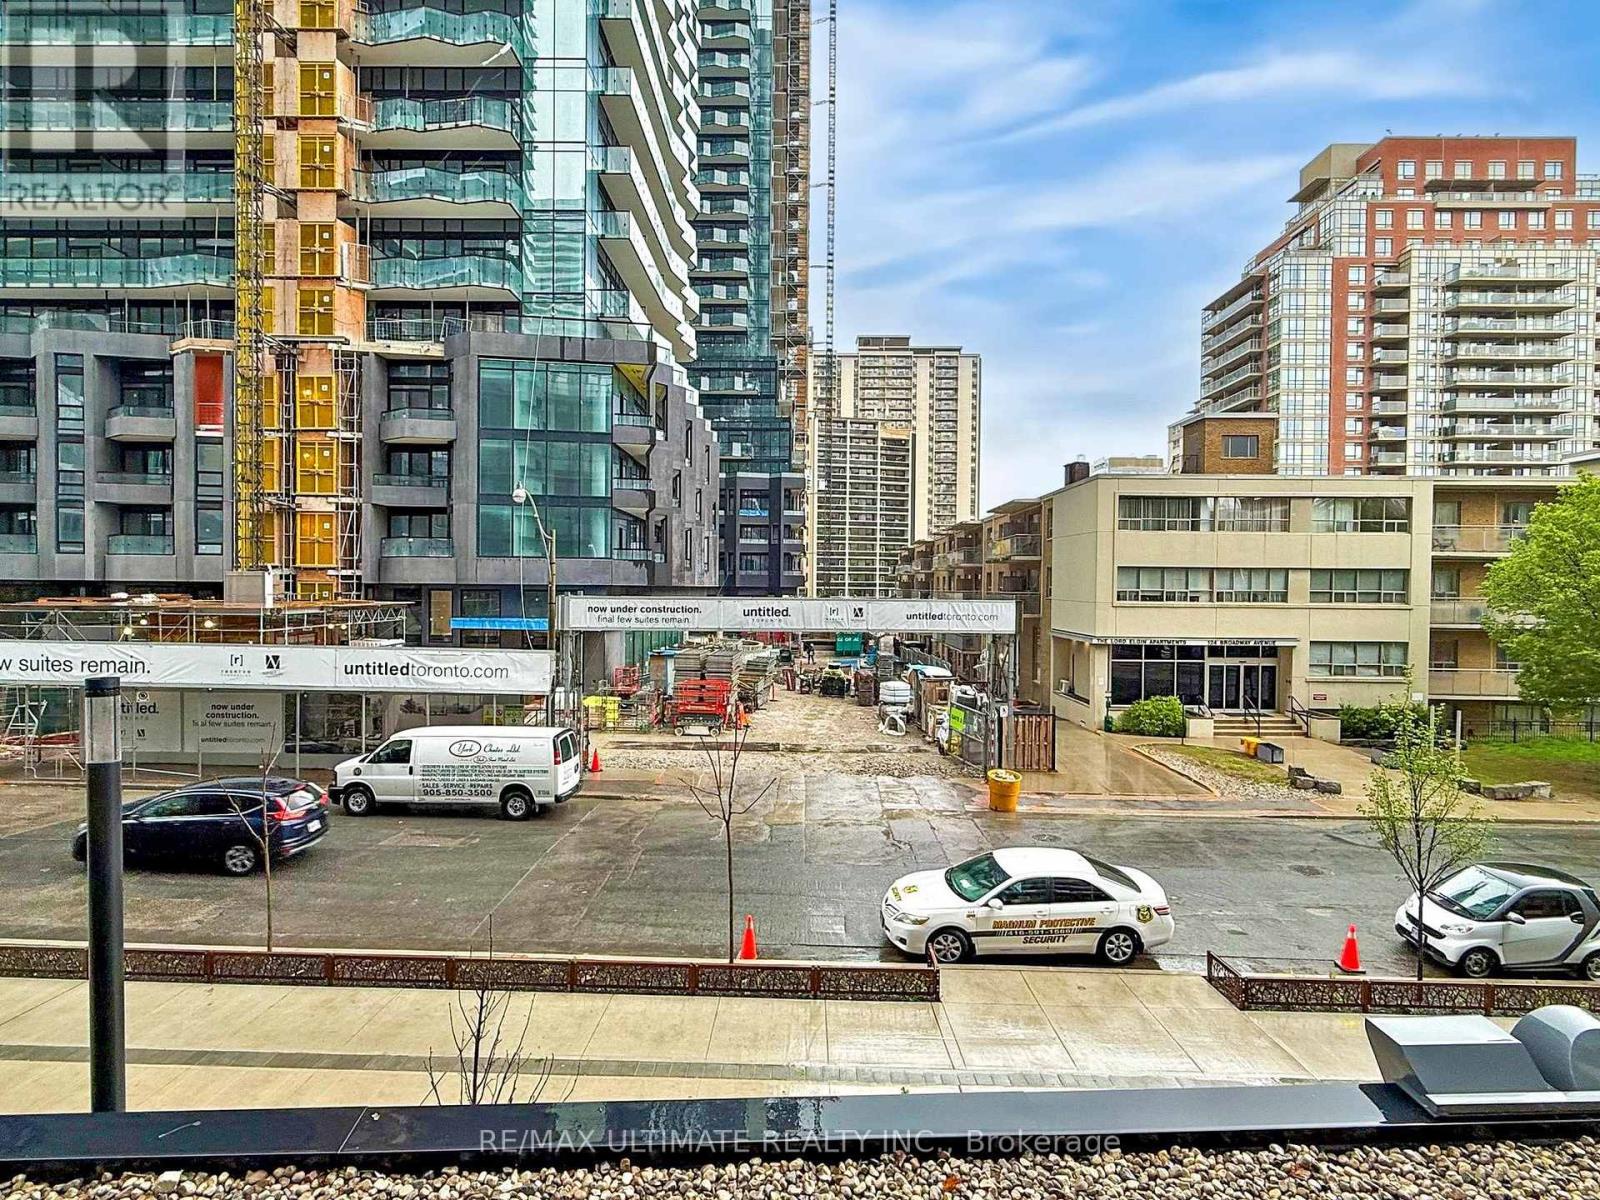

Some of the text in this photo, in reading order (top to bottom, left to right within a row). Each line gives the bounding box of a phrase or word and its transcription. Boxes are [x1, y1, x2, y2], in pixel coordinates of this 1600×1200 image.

[588, 604, 702, 614] now under construction.
[743, 606, 791, 617] untitled.
[598, 615, 614, 623] final
[617, 615, 632, 623] few
[906, 612, 998, 621] untitledtoronto.com
[19, 653, 73, 672] suites
[81, 654, 150, 674] remain.
[344, 661, 509, 679] untitledtoronto.com
[205, 711, 259, 719] construction.
[992, 917, 1096, 929] MAGNUM PROTECTIVE
[1022, 935, 1068, 944] SECURITY
